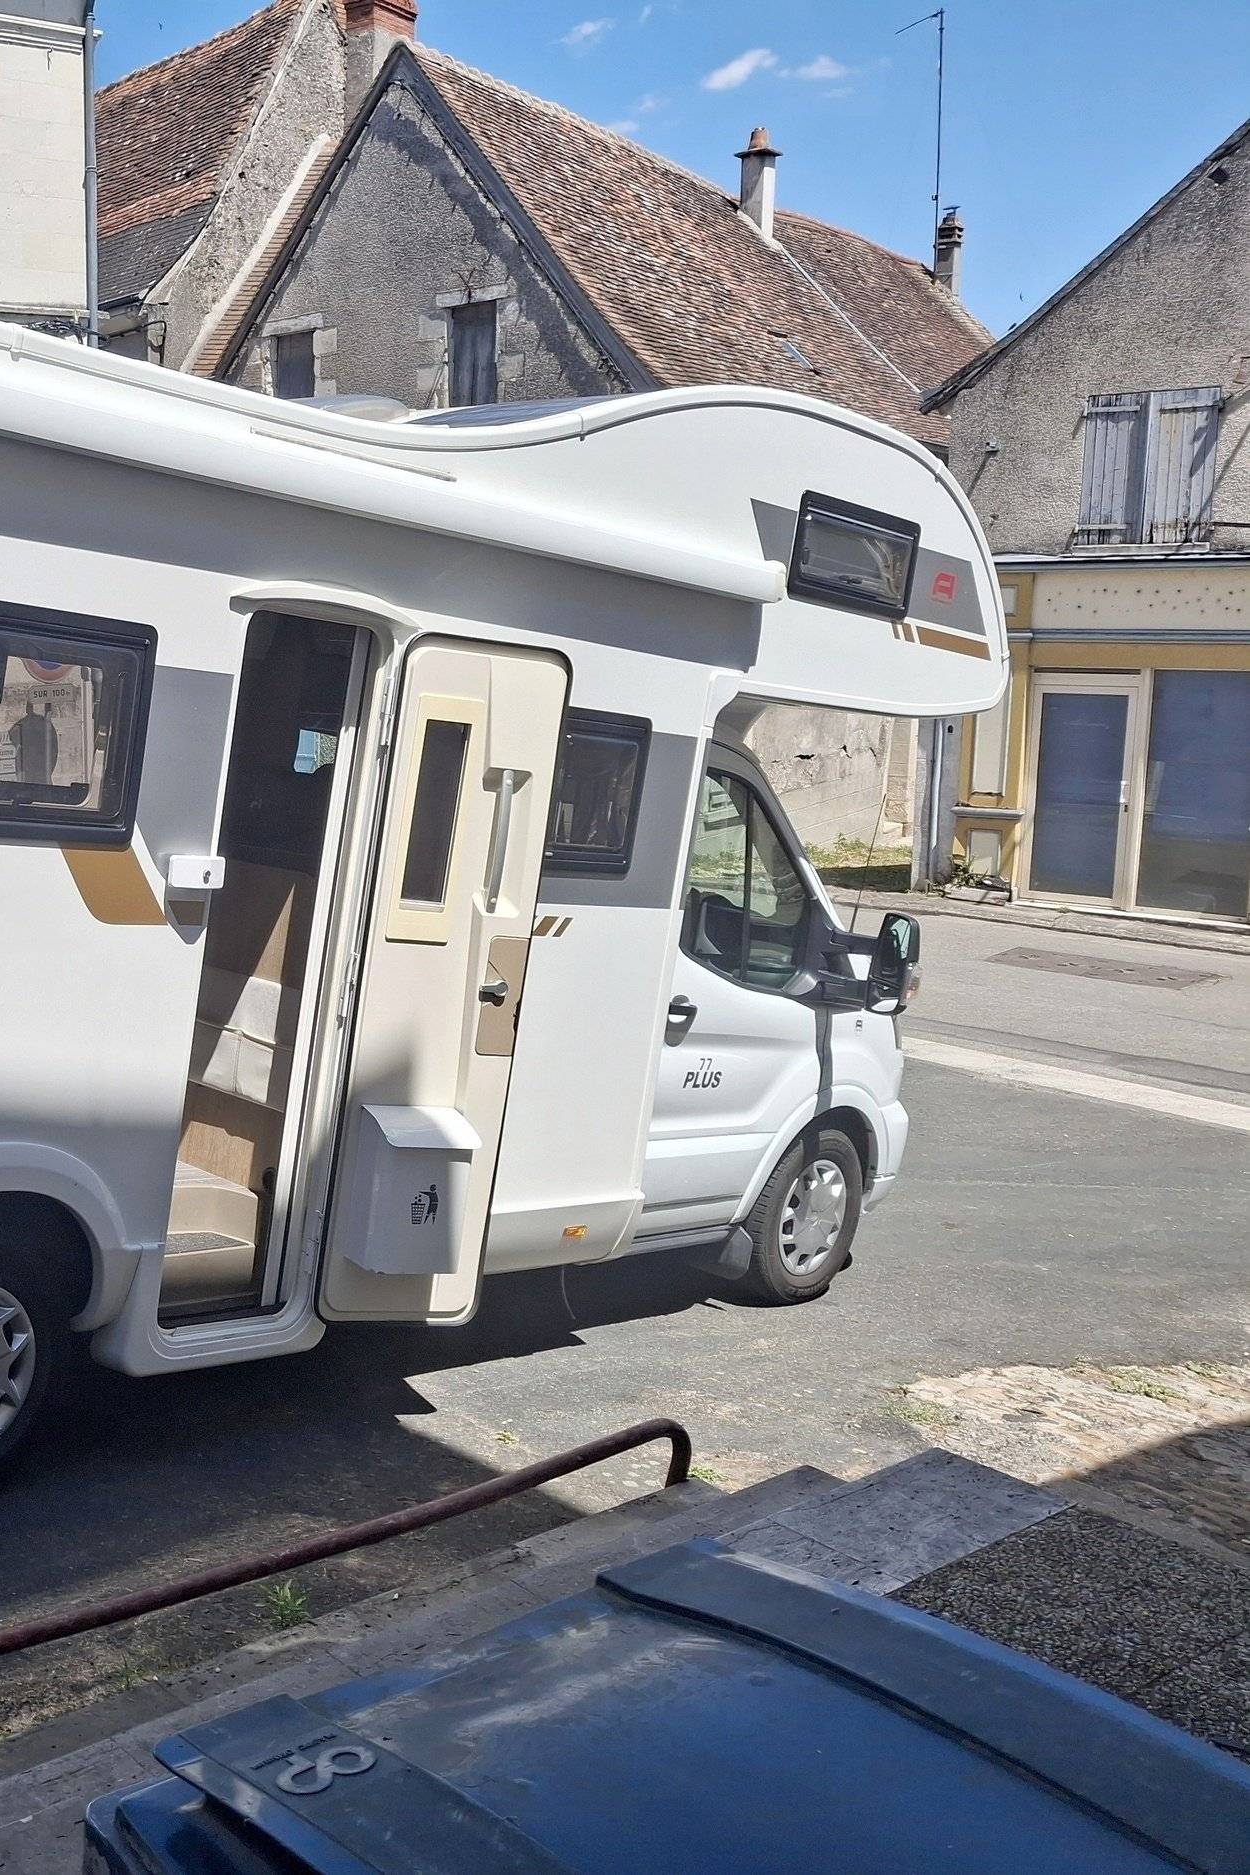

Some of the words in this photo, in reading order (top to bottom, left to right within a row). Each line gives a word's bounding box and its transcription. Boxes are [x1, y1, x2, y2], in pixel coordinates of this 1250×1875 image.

[33, 689, 48, 699] SUR
[699, 1058, 713, 1072] 77
[682, 1070, 723, 1090] PLUS
